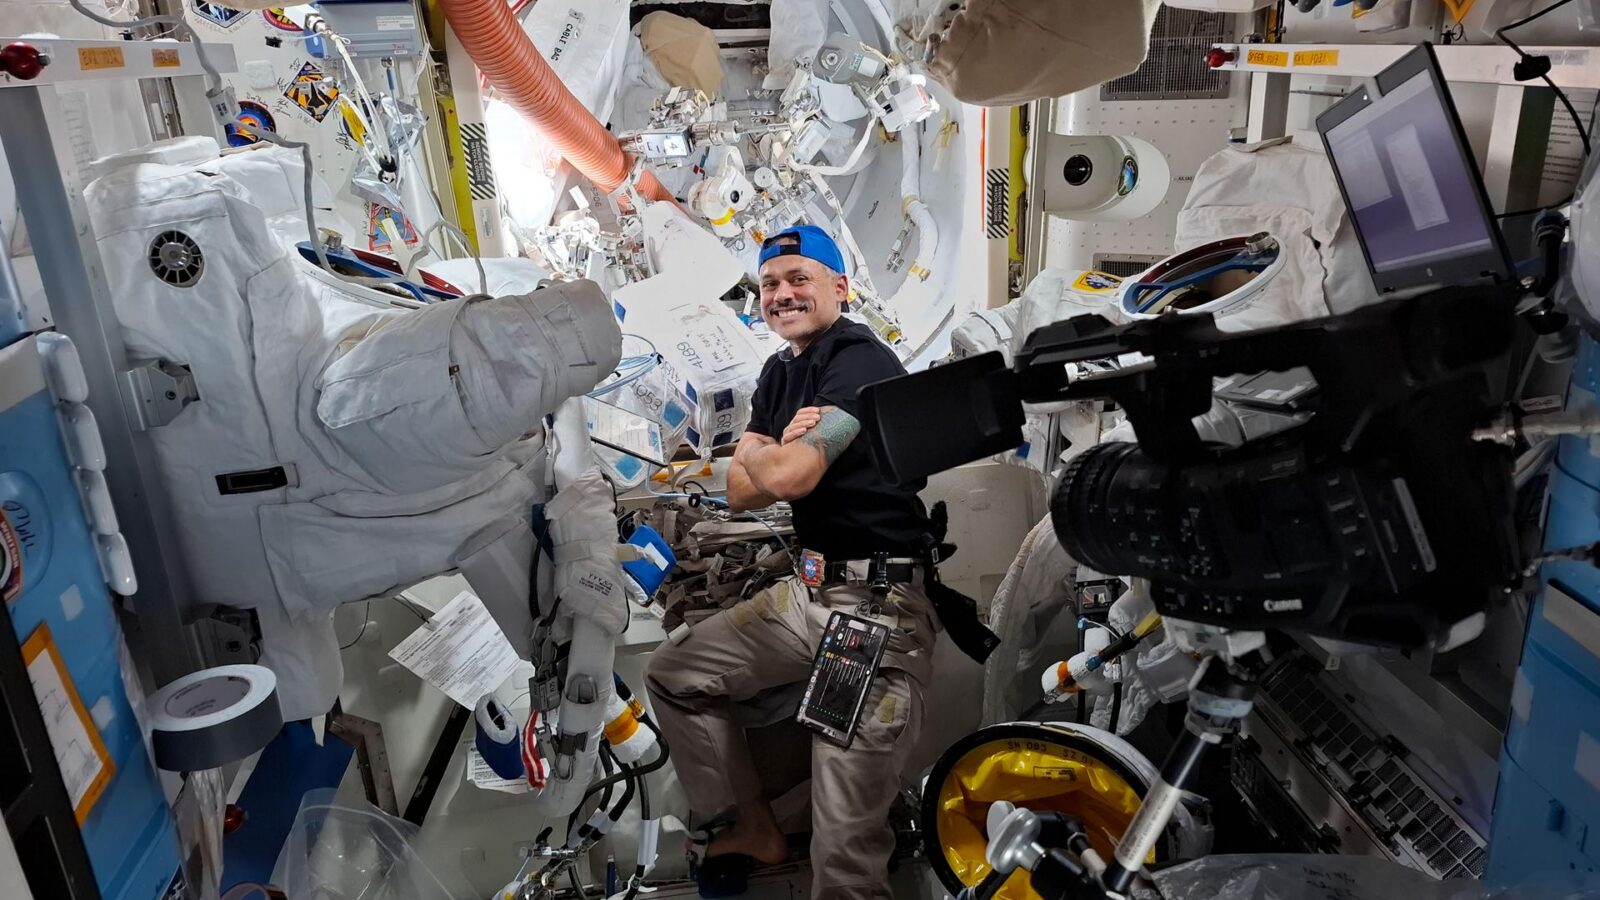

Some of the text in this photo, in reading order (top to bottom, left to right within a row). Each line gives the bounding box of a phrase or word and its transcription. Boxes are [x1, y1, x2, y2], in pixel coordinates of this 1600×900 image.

[550, 23, 574, 61] CABLE BAG
[676, 341, 704, 369] 4189
